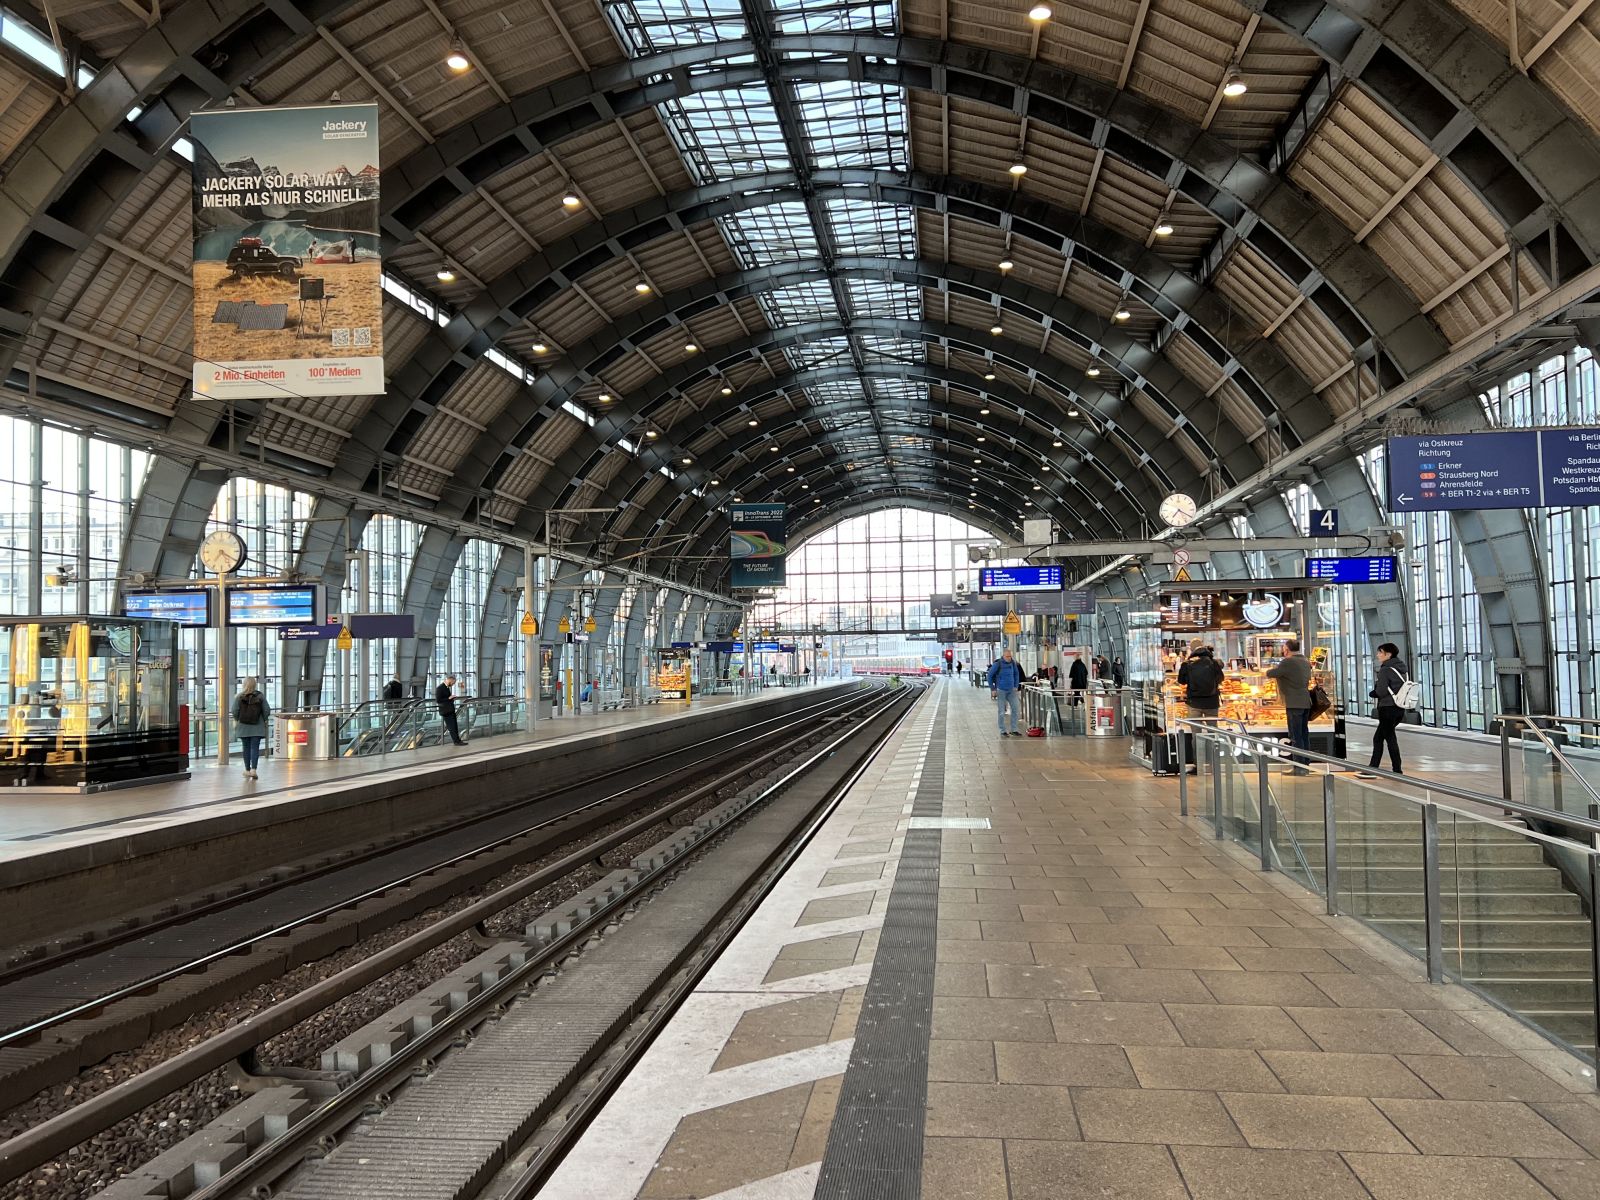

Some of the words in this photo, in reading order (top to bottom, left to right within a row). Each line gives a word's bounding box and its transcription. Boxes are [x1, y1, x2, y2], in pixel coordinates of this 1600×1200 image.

[322, 120, 367, 131] Jackery
[202, 176, 262, 191] JACKERY
[265, 174, 309, 189] SOLAR
[313, 173, 347, 187] WAY.
[202, 193, 241, 208] MEHR
[244, 192, 270, 206] ALS
[273, 191, 301, 205] NUR
[304, 188, 367, 204] SCHNELL.
[214, 371, 221, 380] 2
[223, 371, 242, 380] Mio.
[244, 369, 285, 379] Einheiten
[329, 367, 361, 376] Medien
[1418, 440, 1429, 448] via
[1431, 439, 1463, 447] Ostkreuz
[1418, 449, 1451, 457] Richtung
[1567, 457, 1600, 465] Spandau
[1439, 471, 1478, 479] Strausberg
[1480, 470, 1499, 478] Nord
[1439, 480, 1483, 488] Ahrensfelde
[1553, 476, 1585, 484] Potsdam
[1448, 489, 1464, 497] BER
[1520, 487, 1530, 495] T5
[1569, 485, 1600, 494] Spandau
[1320, 509, 1335, 531] 4
